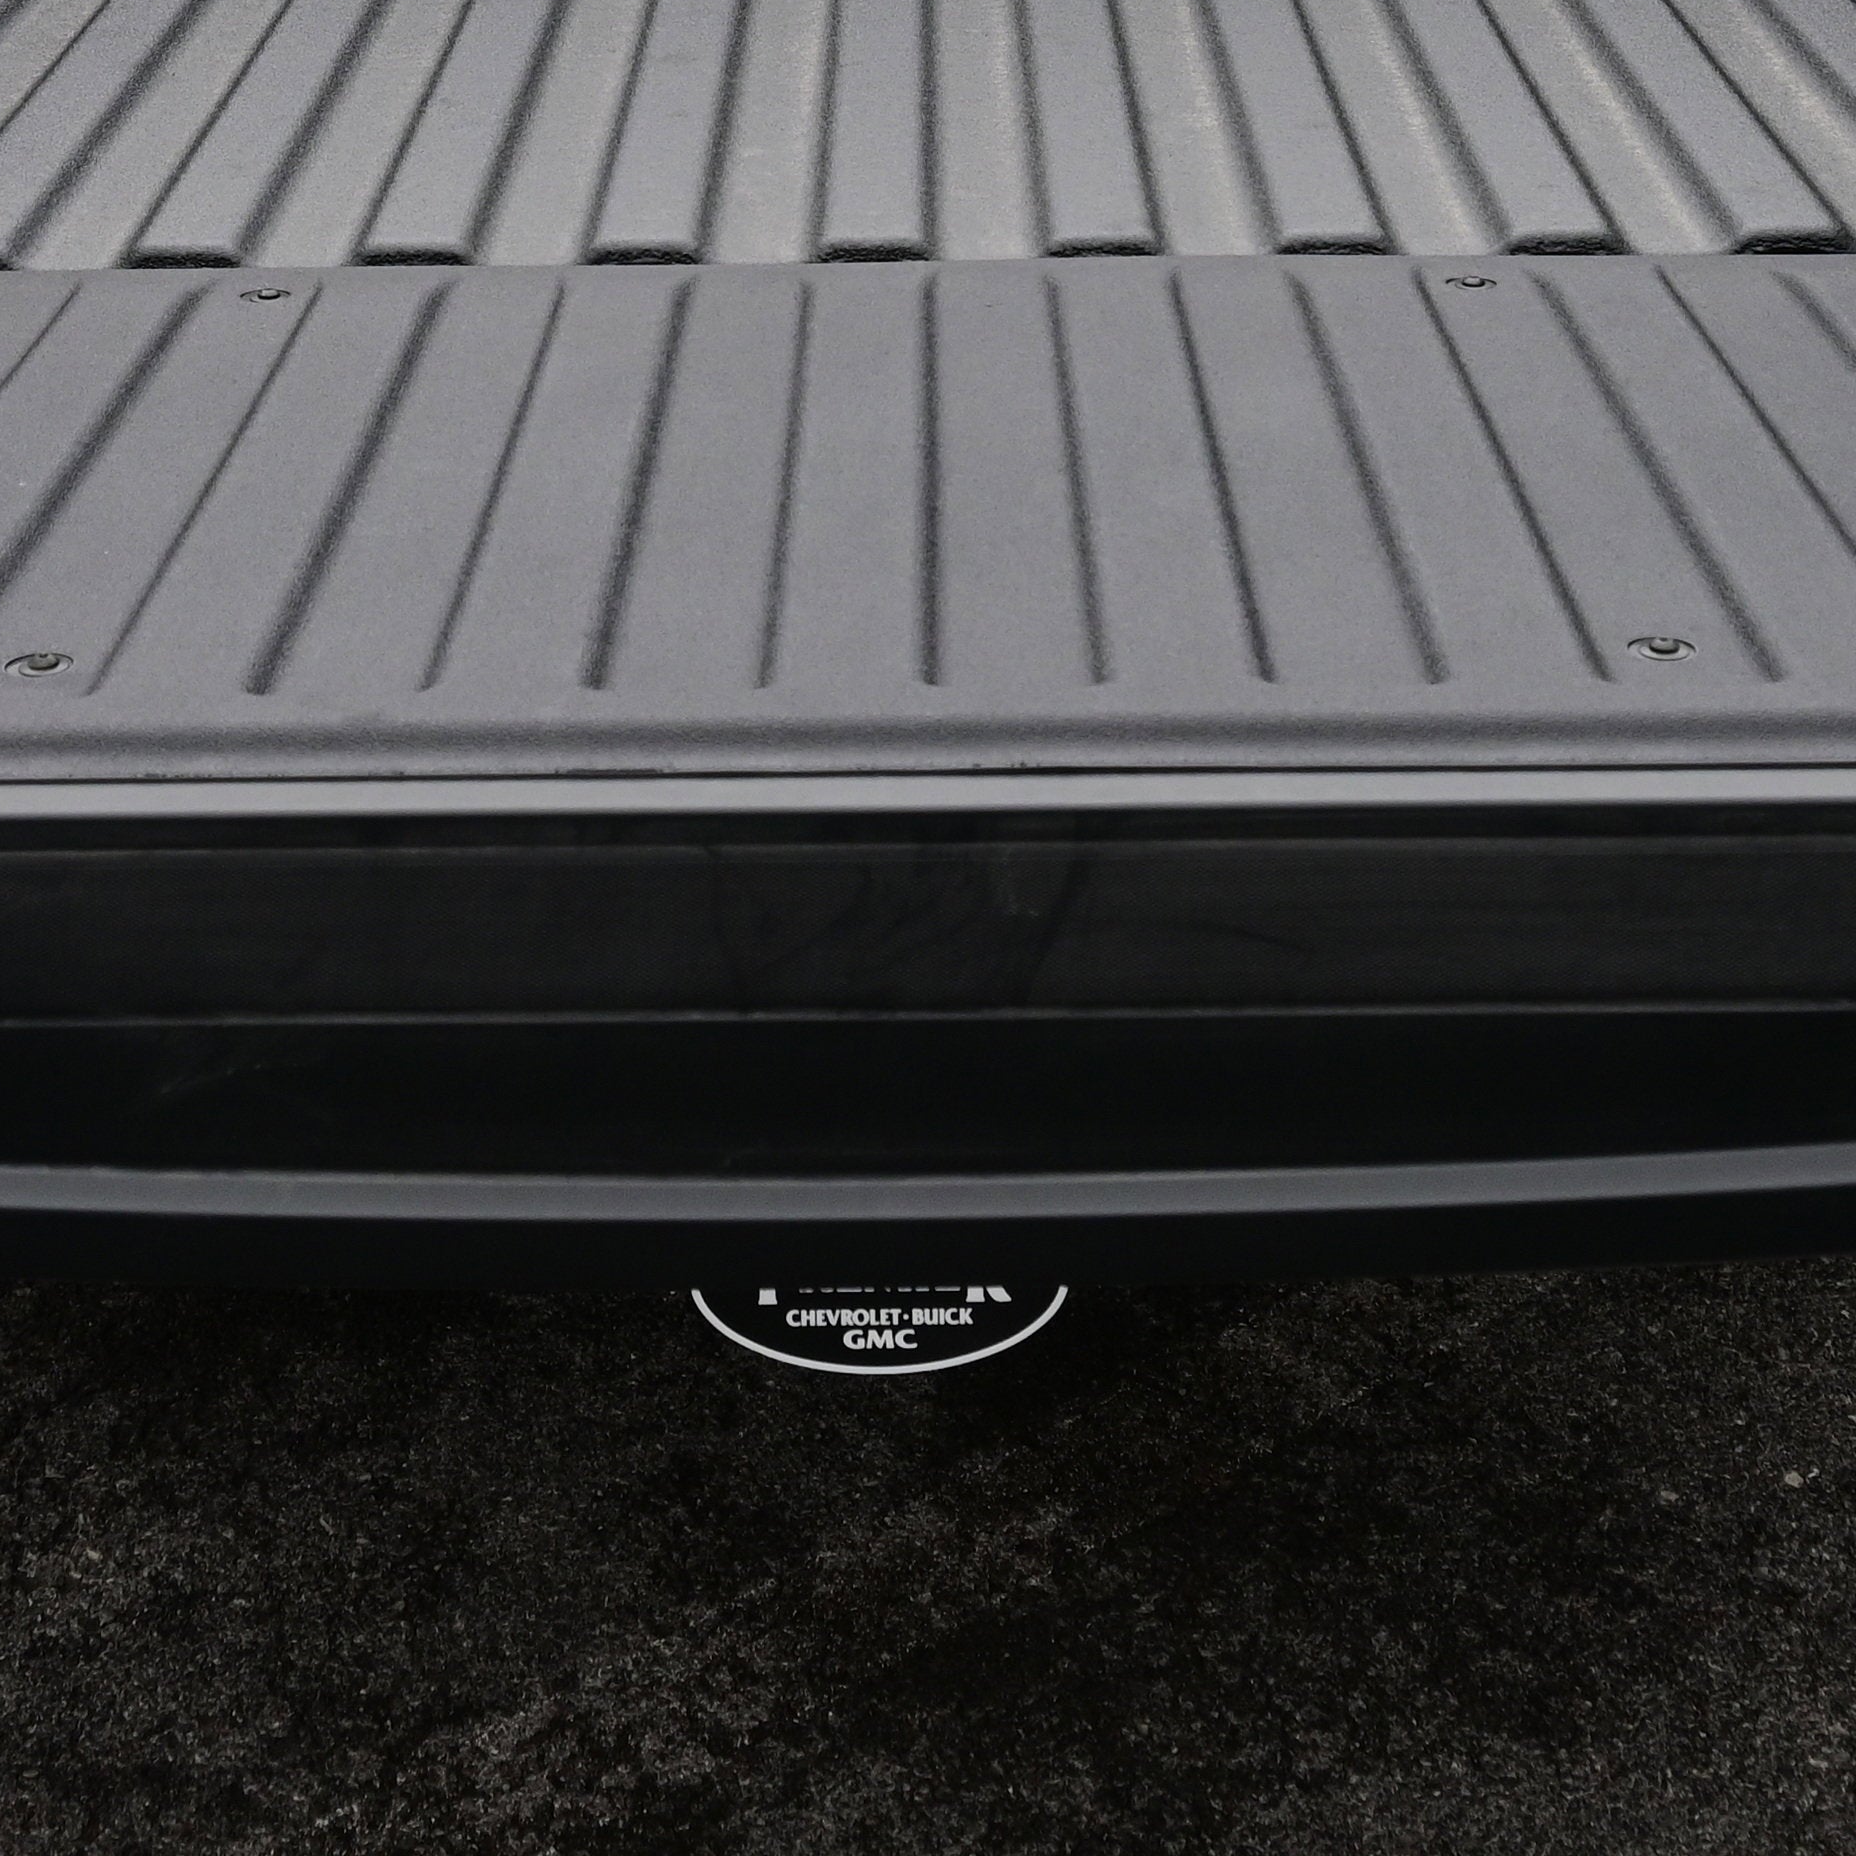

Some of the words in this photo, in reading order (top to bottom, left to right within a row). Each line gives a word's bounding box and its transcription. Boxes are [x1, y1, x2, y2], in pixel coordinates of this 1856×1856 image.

[785, 1308, 901, 1327] CHEVROLET
[911, 1307, 974, 1327] BUICK
[842, 1328, 918, 1350] GMC
